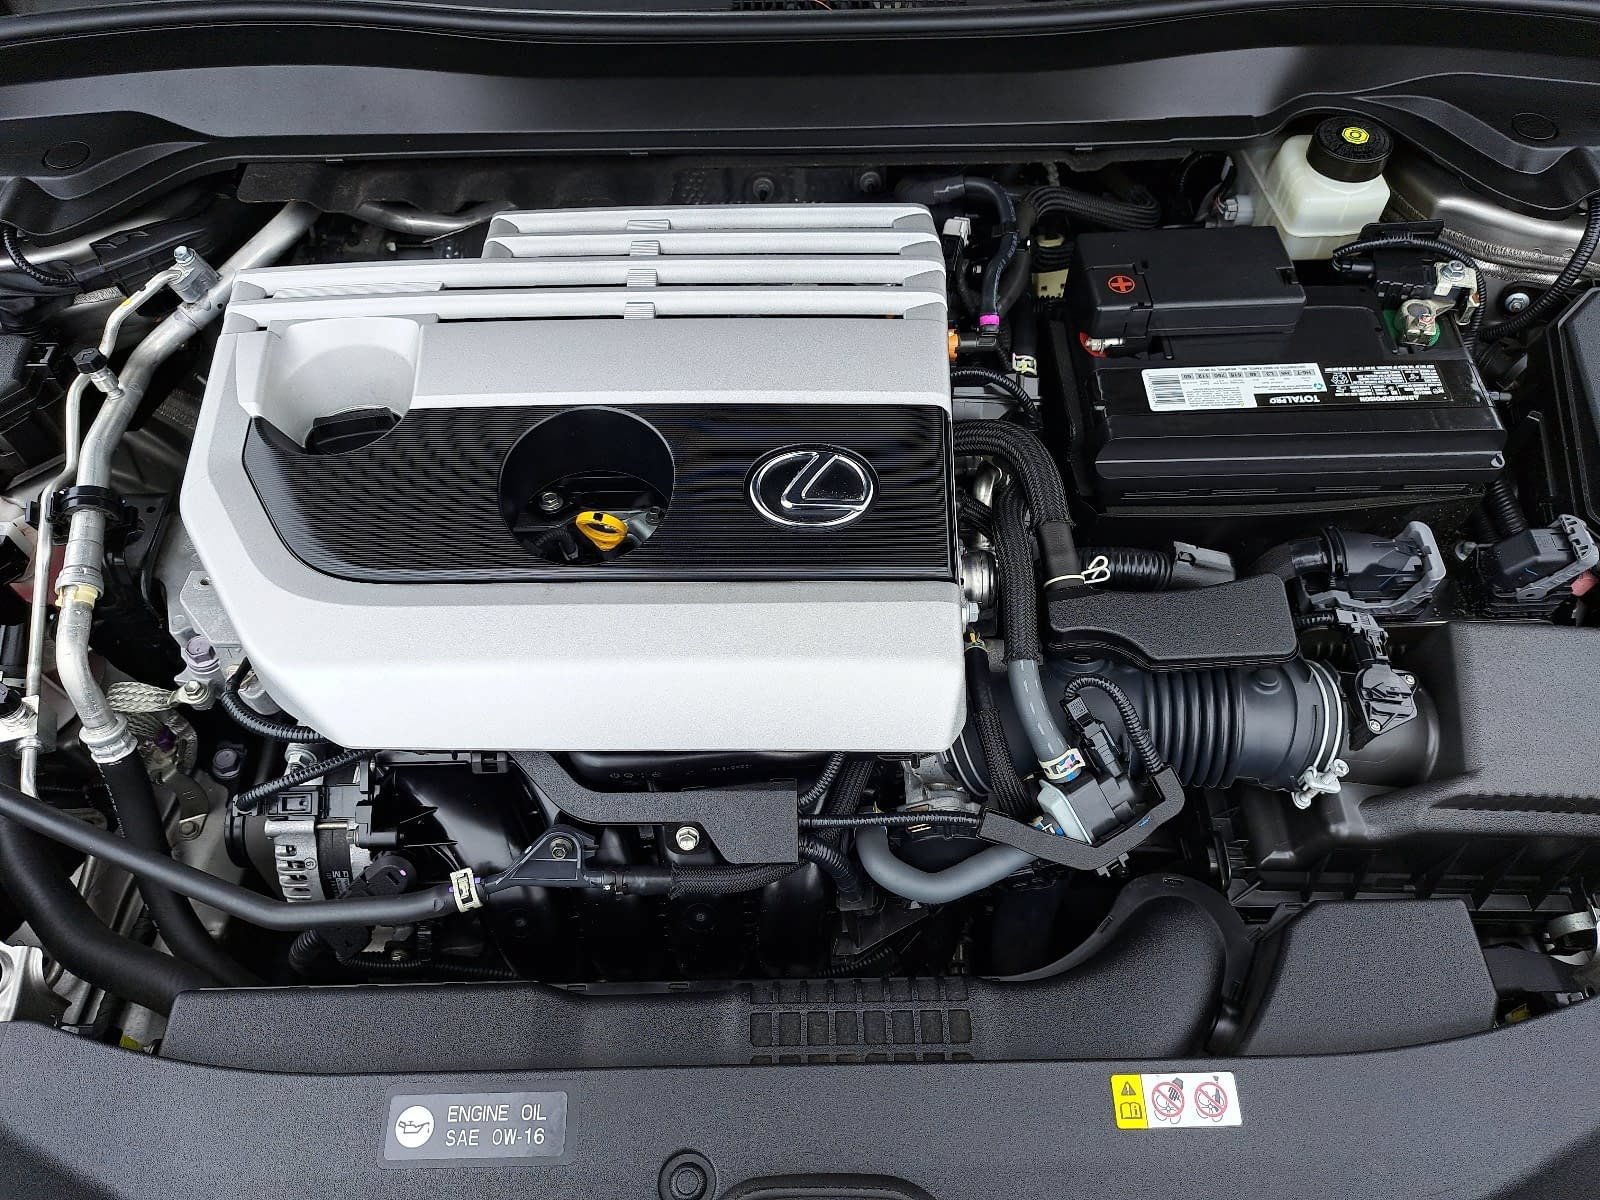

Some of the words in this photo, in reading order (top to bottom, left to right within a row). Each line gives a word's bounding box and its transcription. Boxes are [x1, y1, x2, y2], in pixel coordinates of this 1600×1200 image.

[447, 1104, 510, 1122] ENGINE
[521, 1103, 547, 1121] OIL
[445, 1128, 480, 1147] SAE
[492, 1127, 545, 1146] 0W-16
